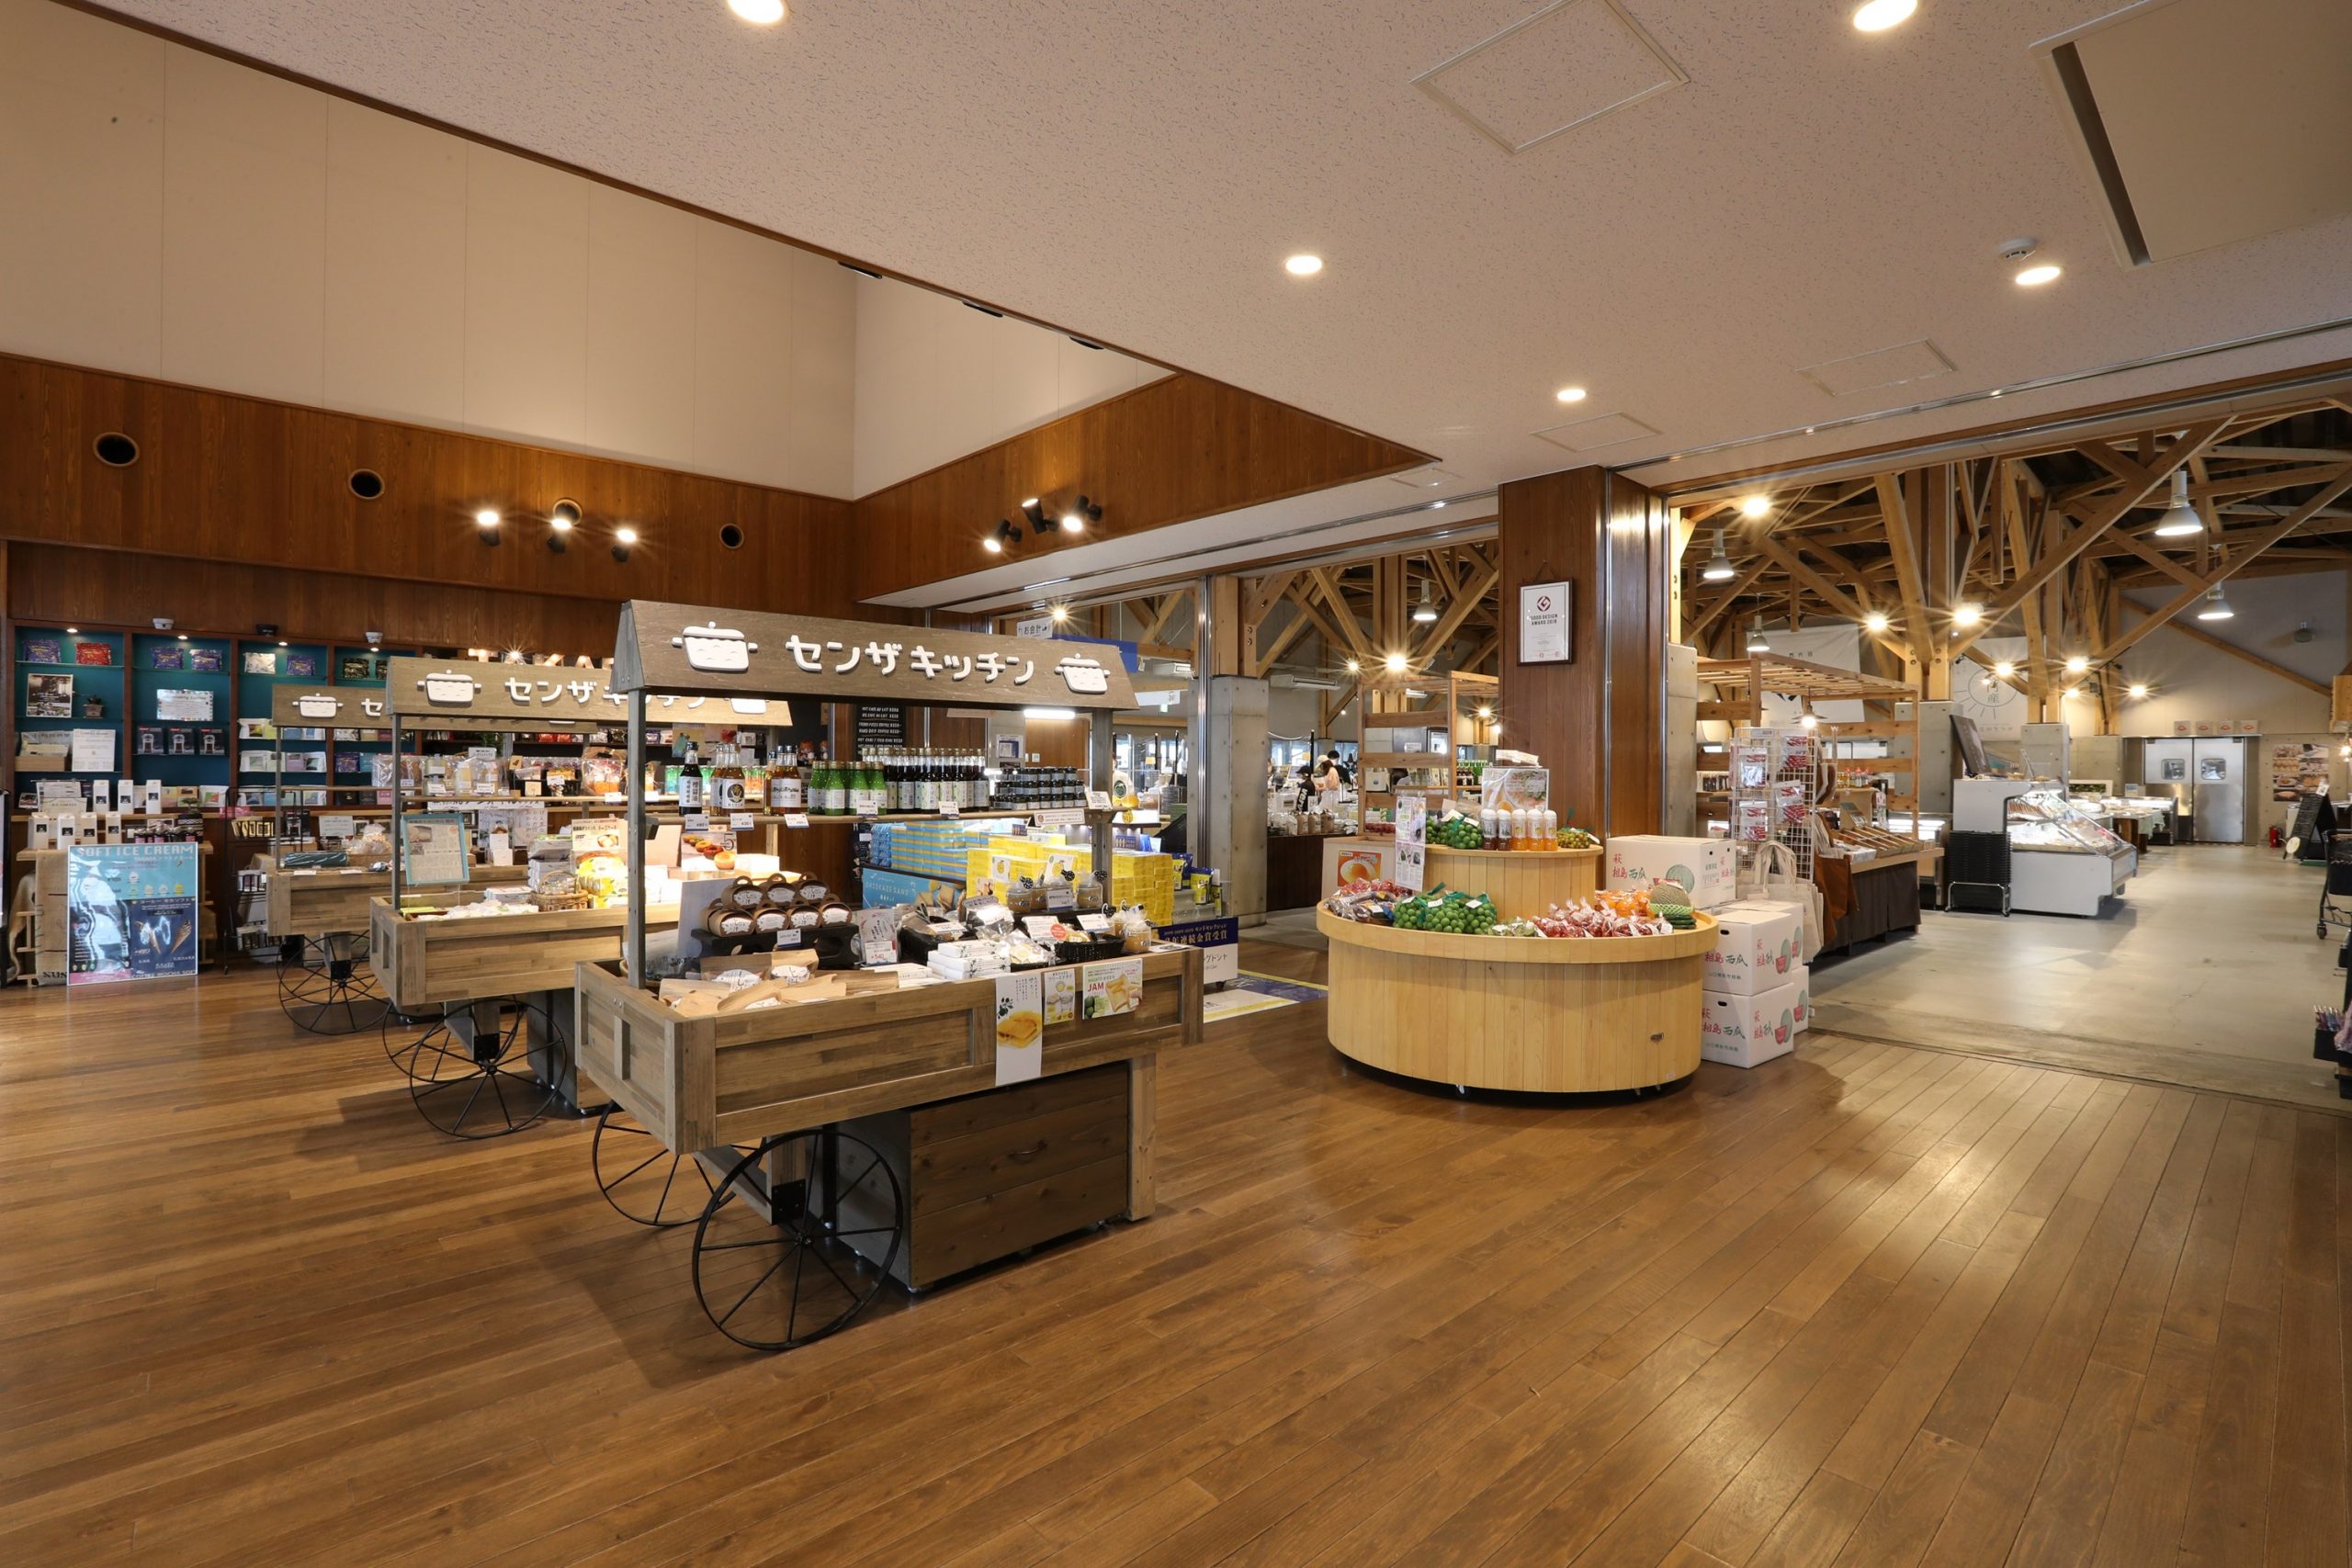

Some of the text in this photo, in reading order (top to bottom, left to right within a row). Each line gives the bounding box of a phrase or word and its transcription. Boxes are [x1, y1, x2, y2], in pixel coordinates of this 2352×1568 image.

[785, 635, 1035, 685] センザキッチン
[117, 846, 140, 856] ICE
[144, 845, 194, 855] CREAM
[1088, 982, 1104, 992] JAM
